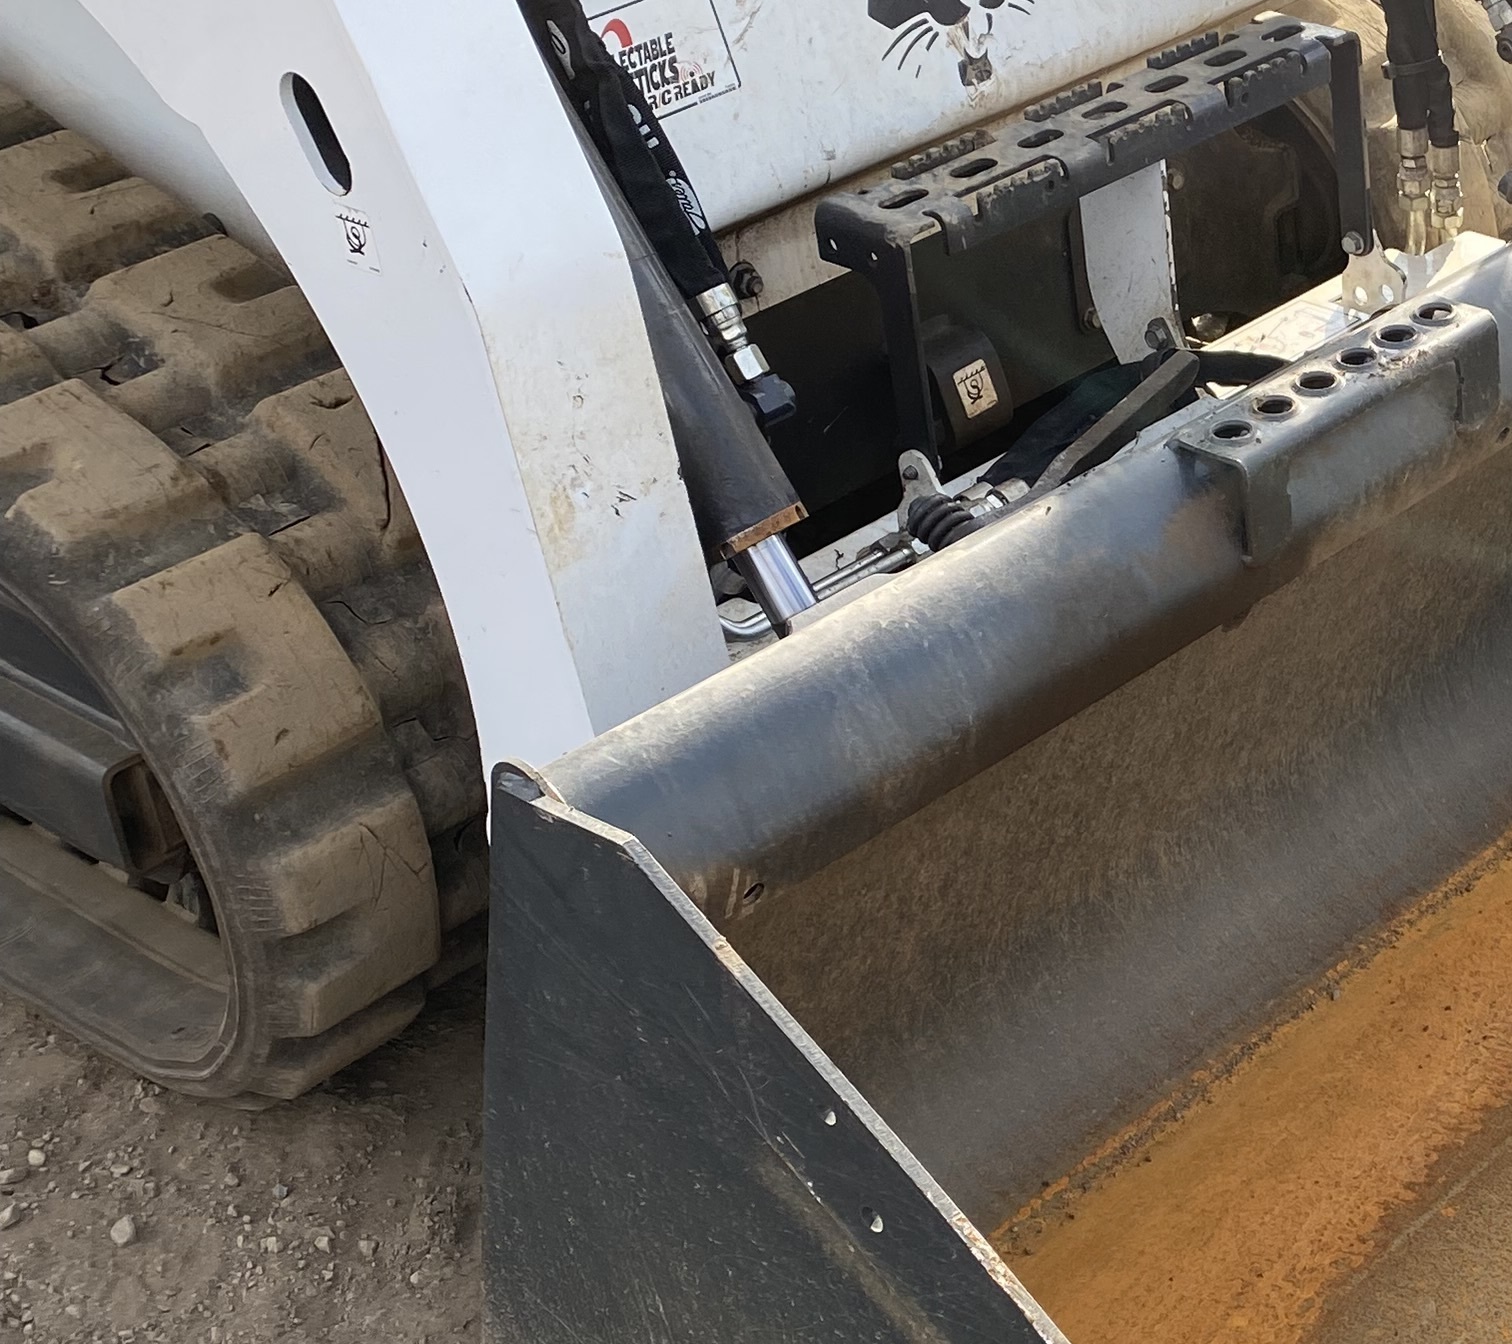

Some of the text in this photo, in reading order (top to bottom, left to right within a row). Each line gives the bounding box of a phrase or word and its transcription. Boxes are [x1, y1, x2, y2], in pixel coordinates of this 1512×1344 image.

[618, 32, 676, 72] ECTABLE
[629, 55, 680, 98] TICKS
[673, 71, 716, 101] READY
